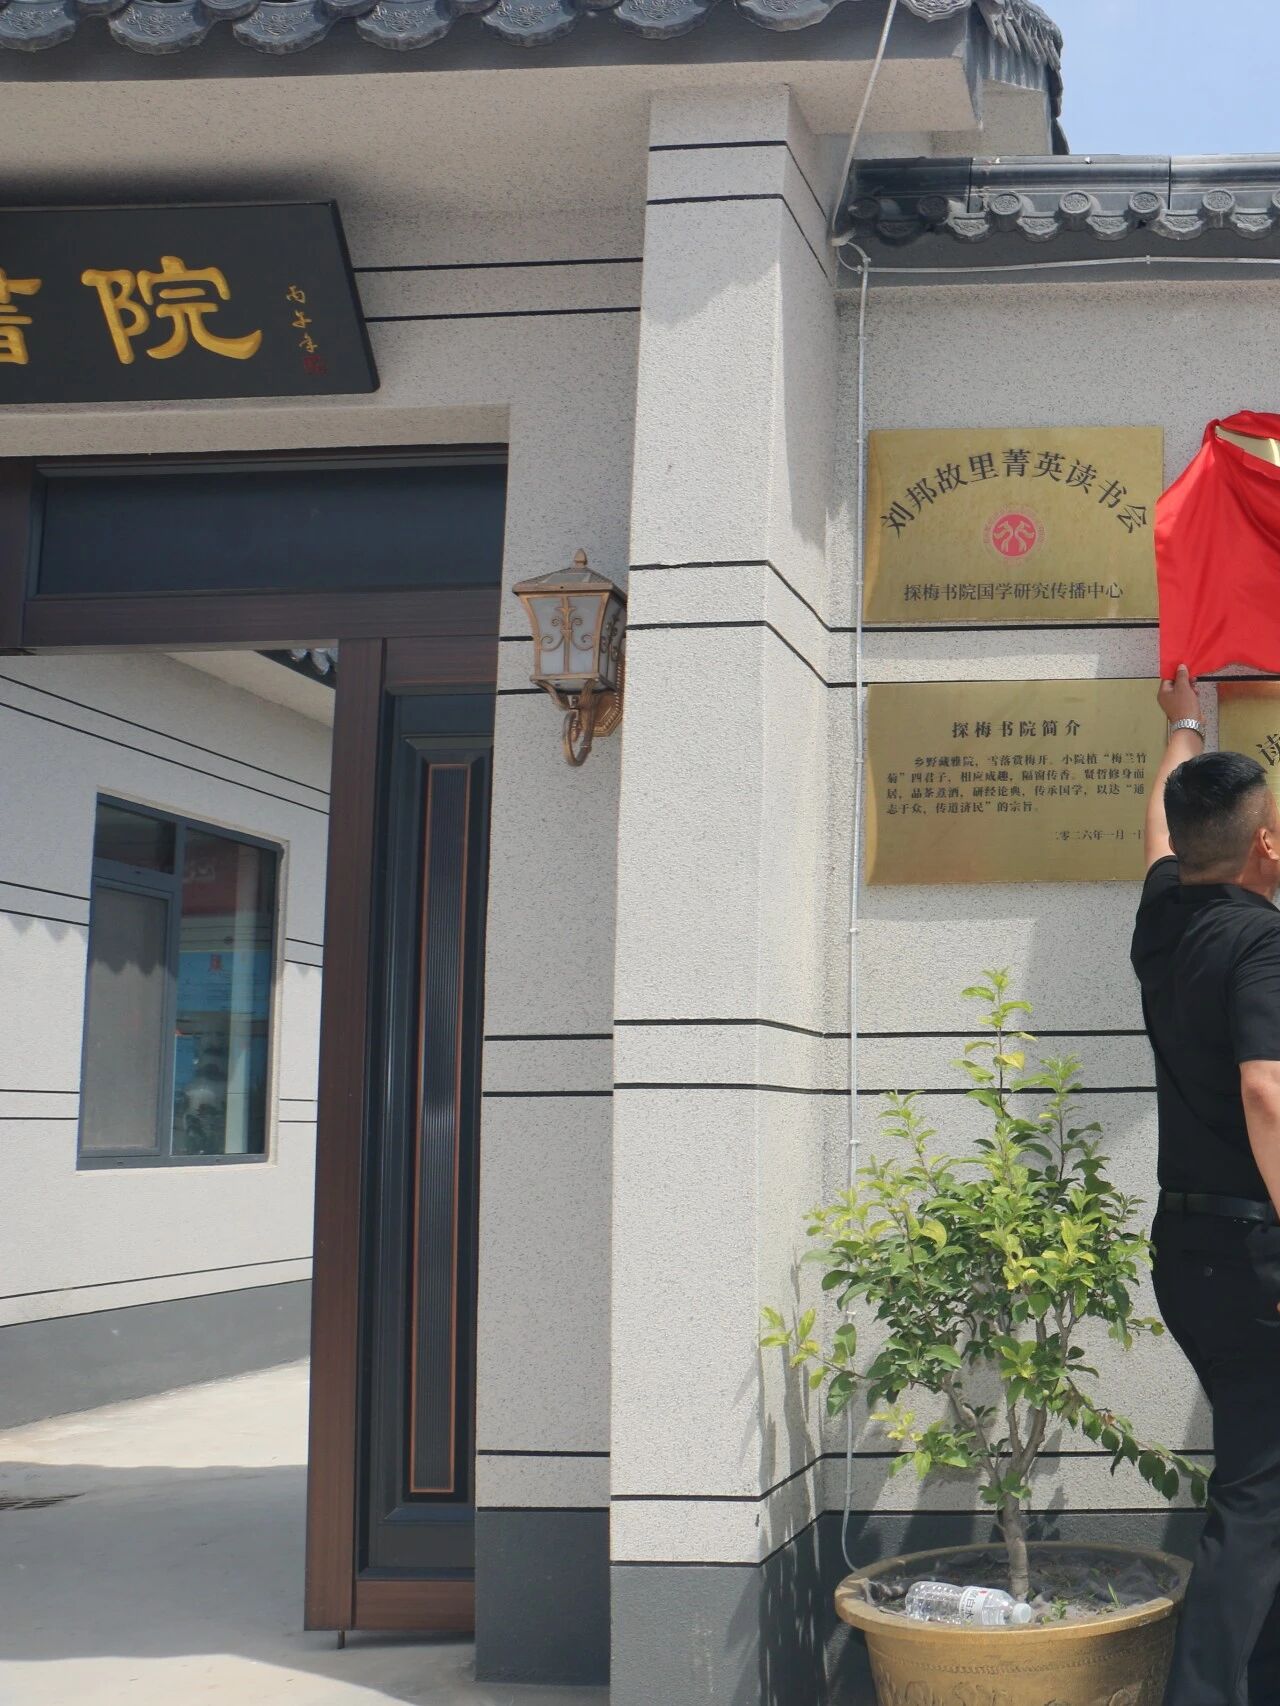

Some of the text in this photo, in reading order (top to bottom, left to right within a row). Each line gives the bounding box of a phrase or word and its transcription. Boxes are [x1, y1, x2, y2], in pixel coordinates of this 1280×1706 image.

[880, 448, 1147, 538] 刘邦故里菁英读书会
[903, 582, 1123, 601] 探梅书院国学研究传播中心
[952, 719, 1081, 738] 探梅书院简介
